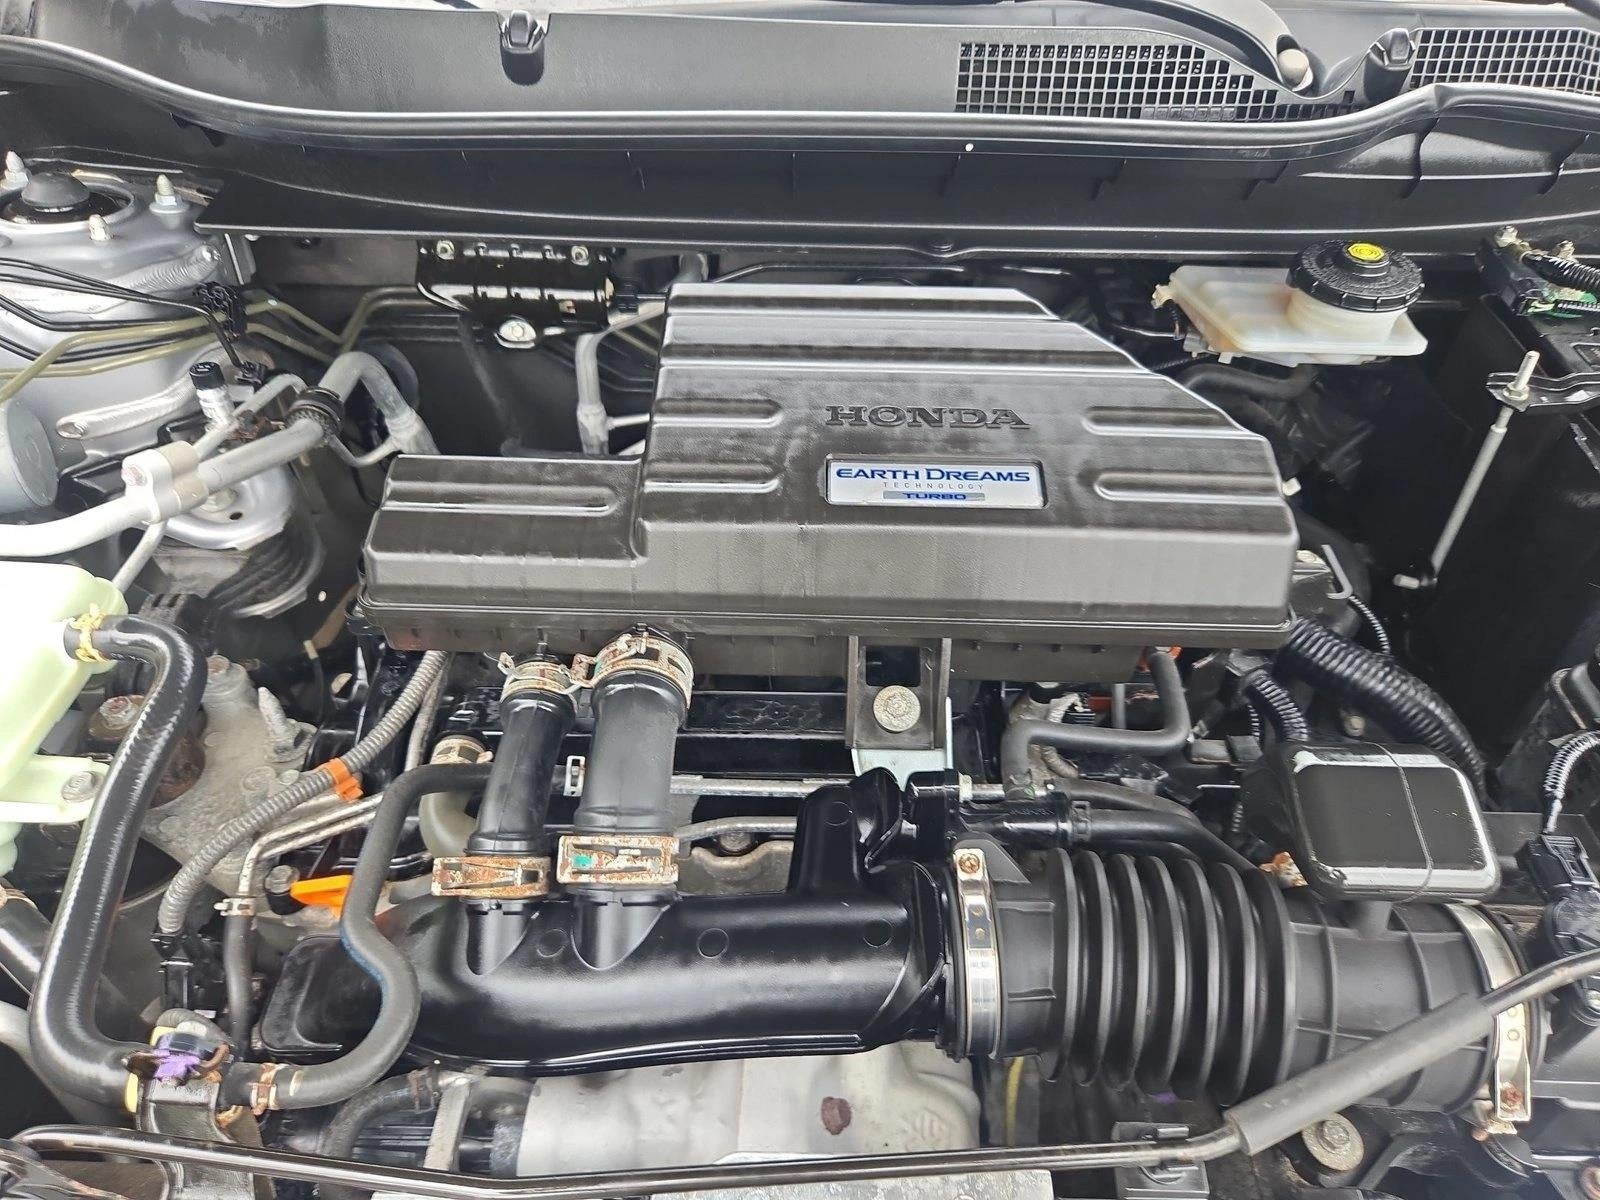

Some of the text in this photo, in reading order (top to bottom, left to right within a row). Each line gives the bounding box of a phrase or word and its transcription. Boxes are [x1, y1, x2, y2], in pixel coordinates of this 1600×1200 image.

[826, 405, 1031, 429] HONDA
[836, 468, 1030, 482] EARTH DREAMS
[883, 482, 984, 490] TECHNOLOGY
[902, 492, 966, 500] TURBO
